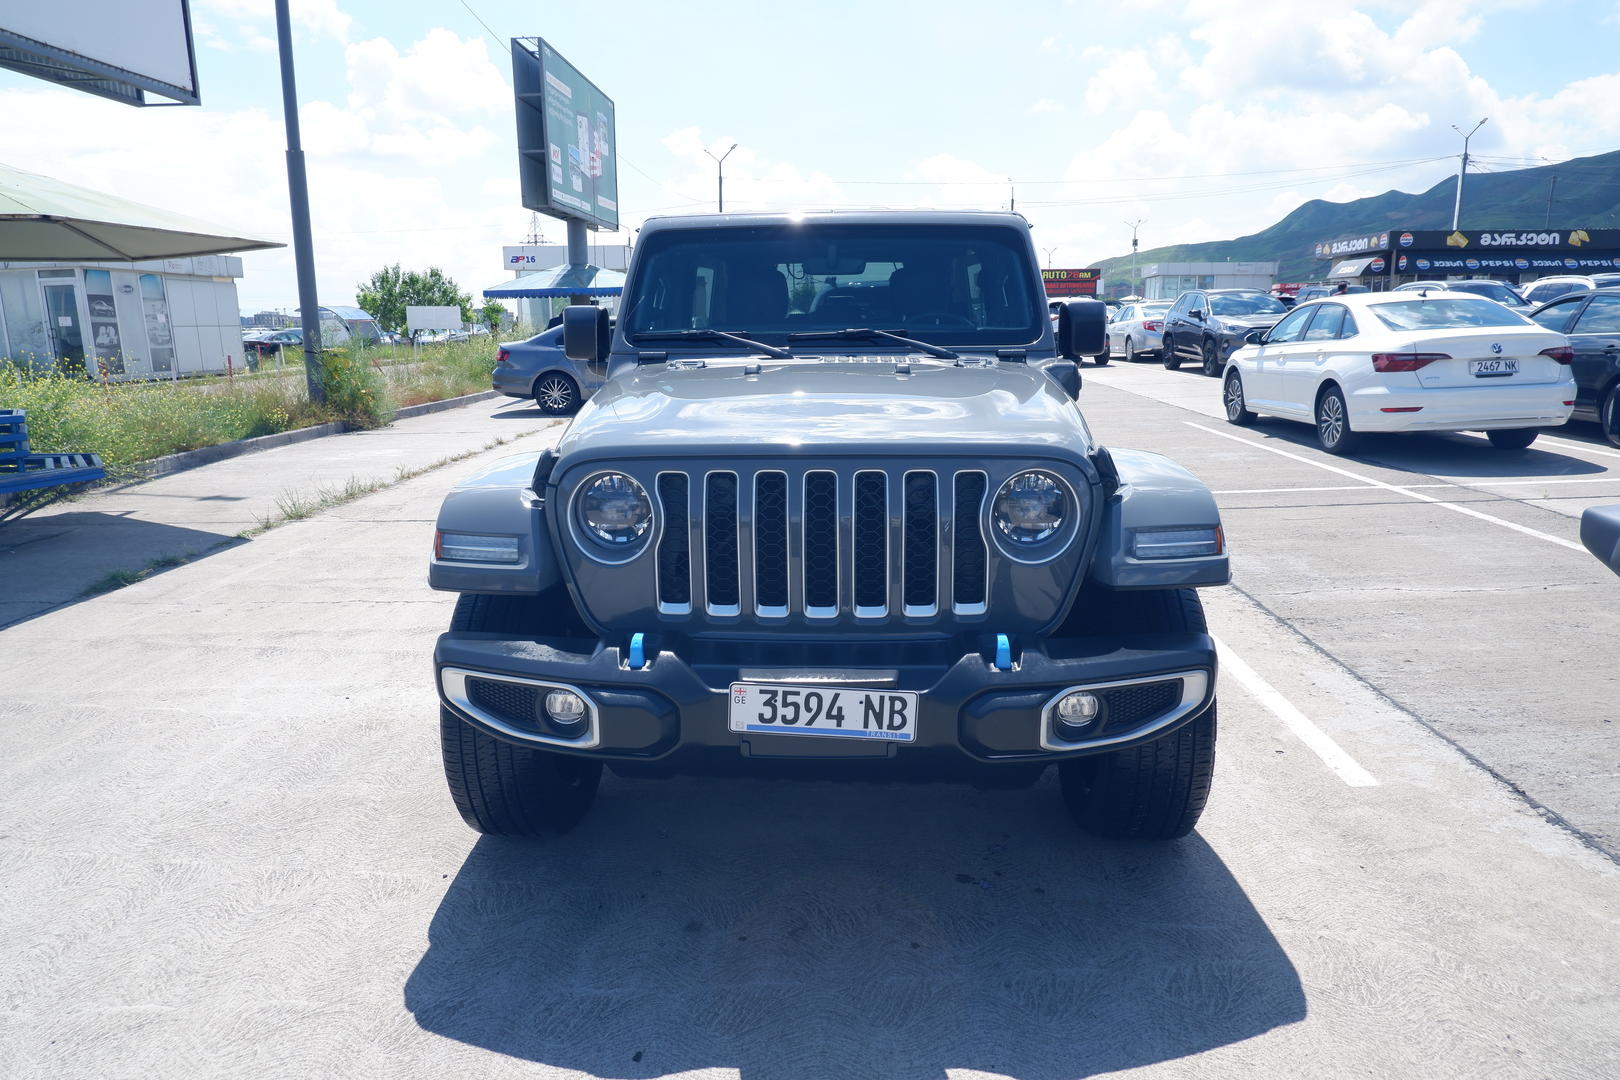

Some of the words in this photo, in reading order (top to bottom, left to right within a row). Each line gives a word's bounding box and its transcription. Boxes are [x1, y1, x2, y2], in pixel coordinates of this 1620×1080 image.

[526, 255, 536, 263] 16
[1477, 362, 1500, 372] 2467
[1504, 361, 1517, 371] NK
[734, 695, 746, 704] GE
[758, 689, 845, 728] 3594
[863, 694, 908, 731] NB
[866, 730, 901, 739] TRANSIT
